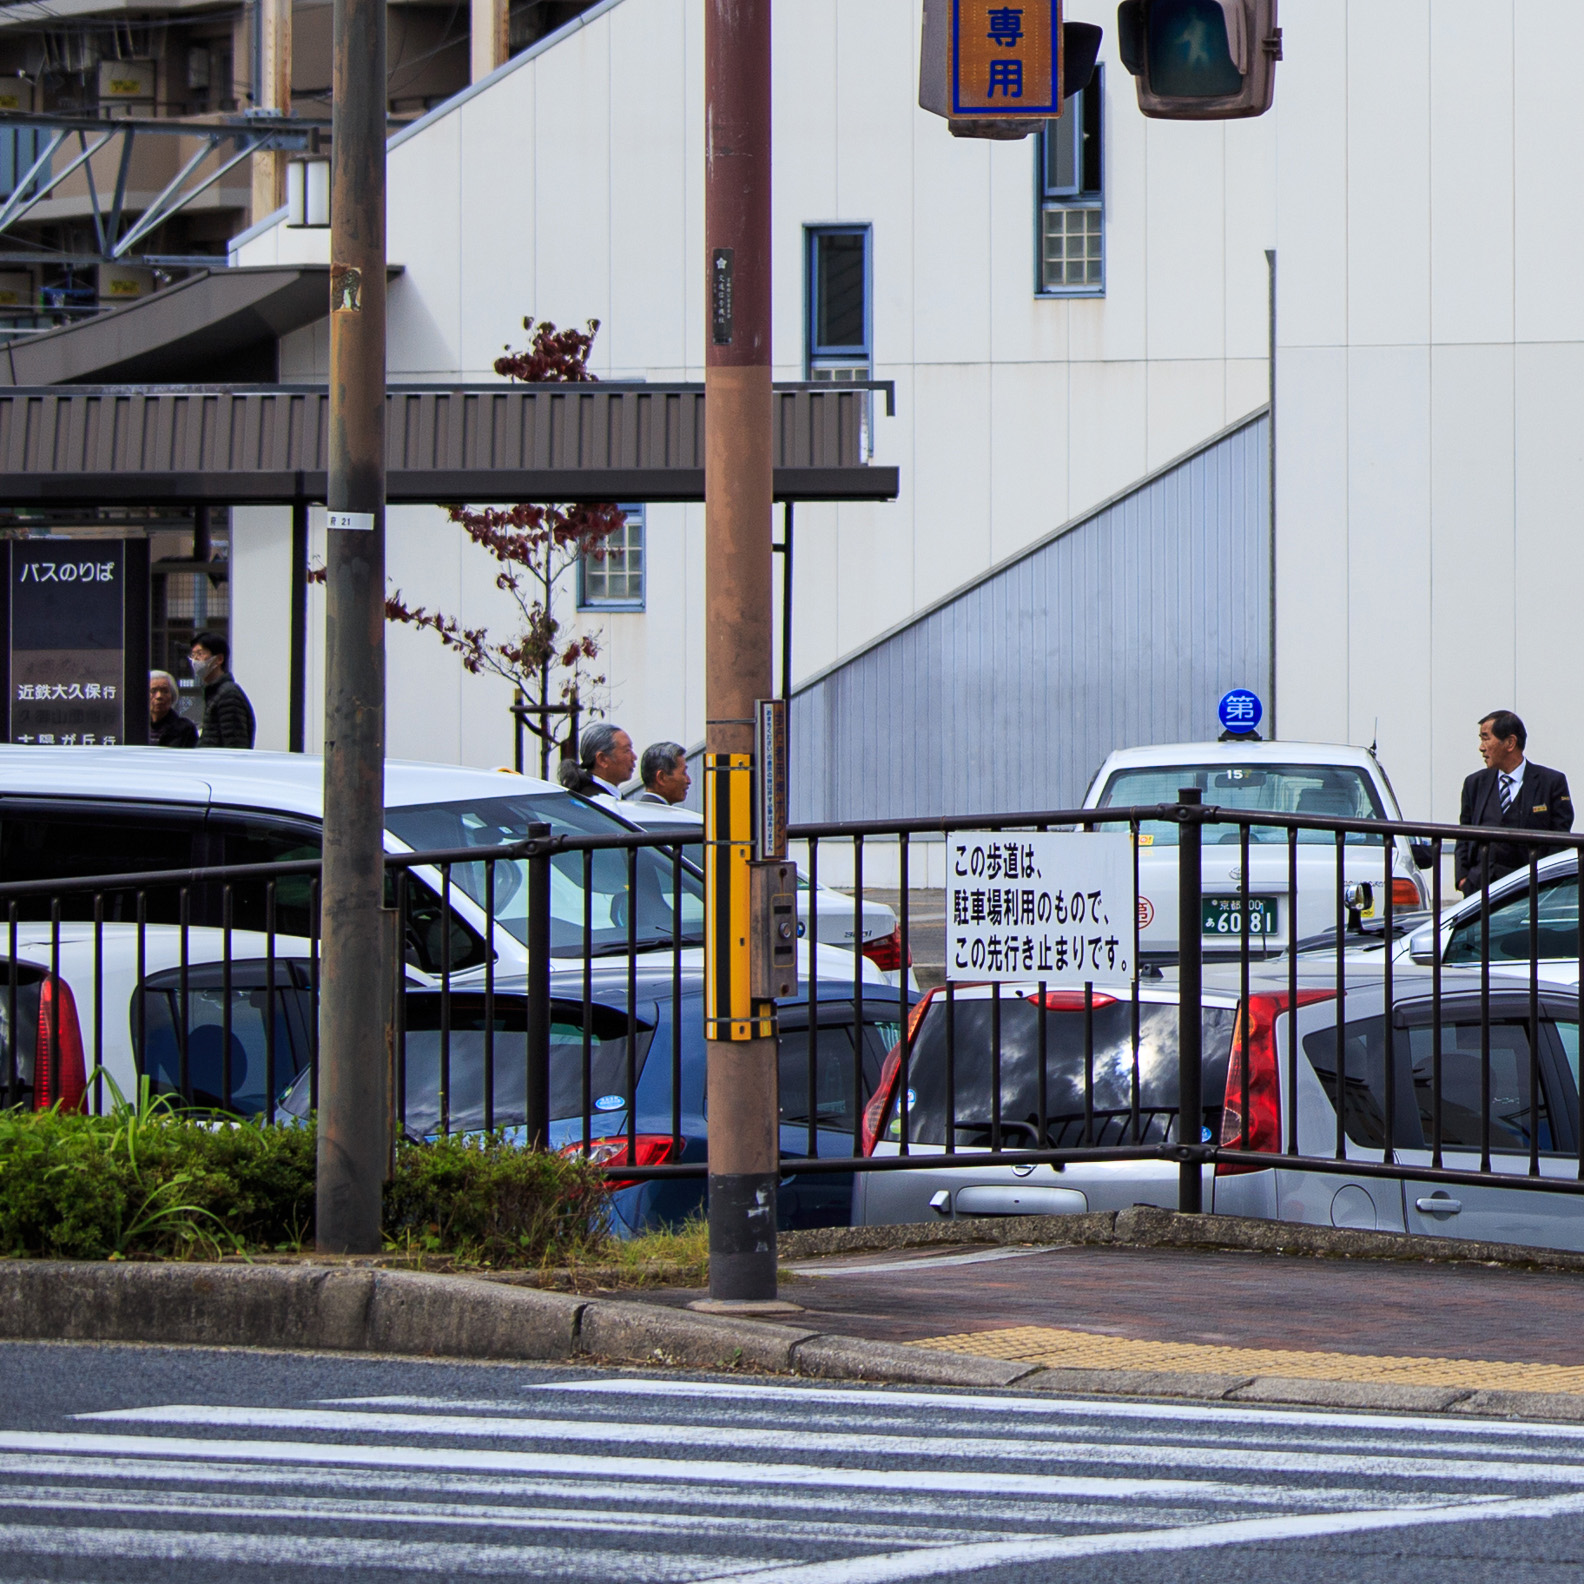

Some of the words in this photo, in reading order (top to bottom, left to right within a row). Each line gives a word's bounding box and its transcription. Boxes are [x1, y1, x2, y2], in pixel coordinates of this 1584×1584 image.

[987, 7, 1023, 99] 専用
[21, 562, 115, 582] バスのりば
[955, 843, 1041, 879] この歩道は、
[953, 889, 1109, 926] 駐車場利用のもので、
[1217, 912, 1271, 932] 6081
[955, 935, 1127, 972] この先行き止まりです。
